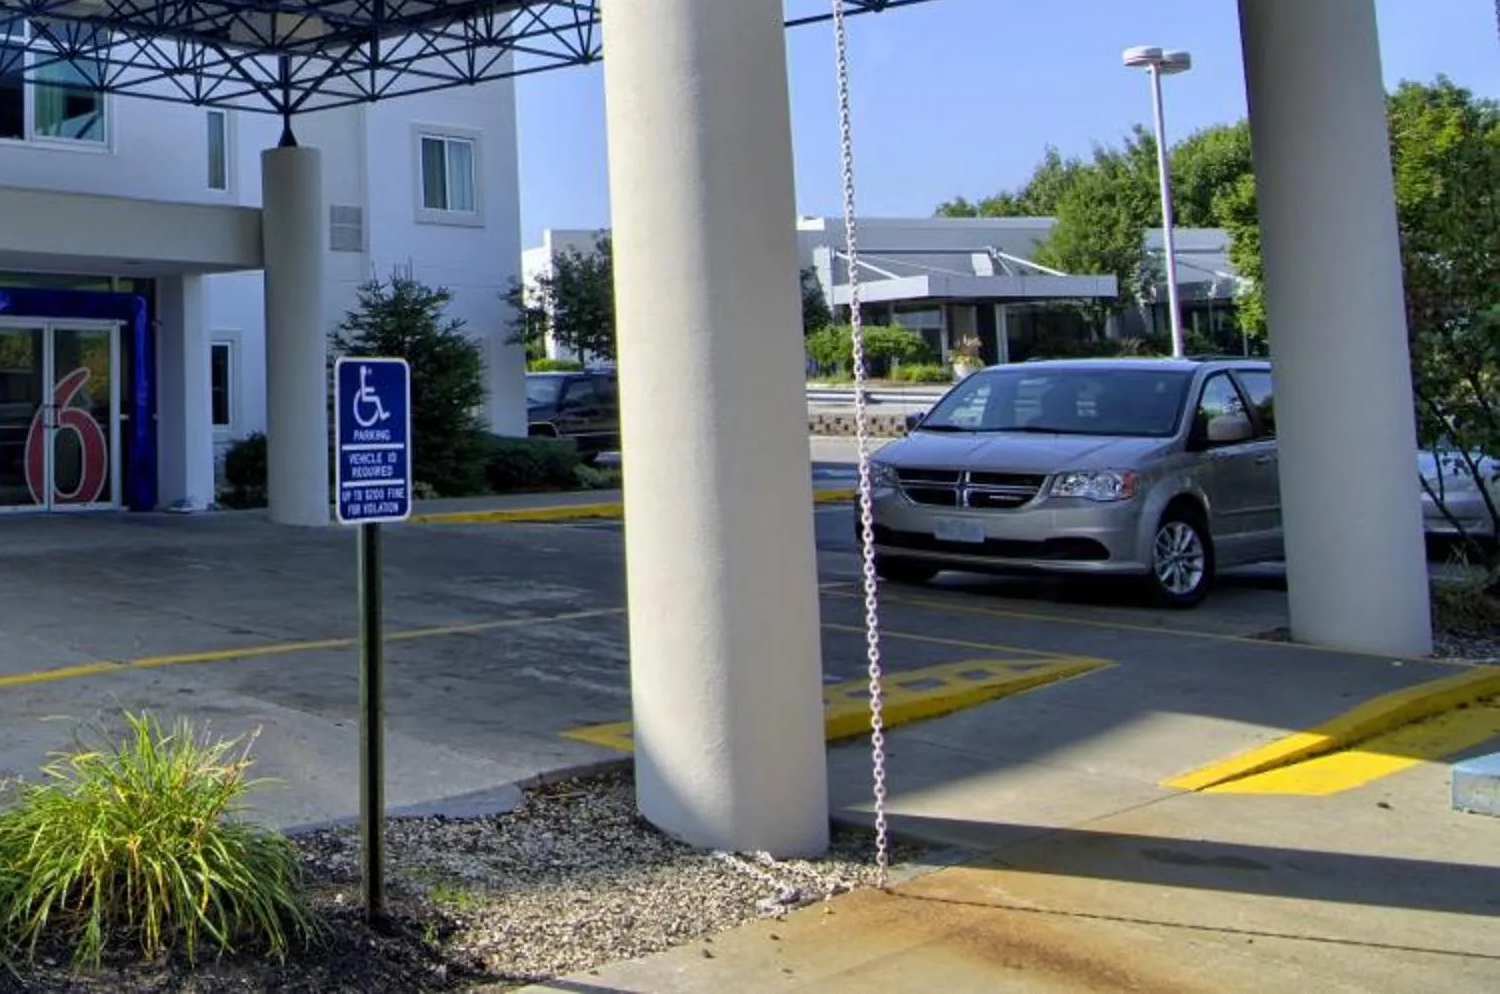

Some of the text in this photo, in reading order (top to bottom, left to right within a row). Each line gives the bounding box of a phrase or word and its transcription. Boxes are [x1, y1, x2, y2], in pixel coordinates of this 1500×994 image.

[24, 366, 108, 506] 6
[353, 430, 390, 441] PARKING
[349, 452, 382, 464] VEHICLE
[352, 466, 392, 477] REQUIRED
[342, 491, 350, 501] UP
[354, 490, 362, 500] TO
[387, 487, 405, 499] FINE
[348, 501, 399, 516] FOR VIOLATION
